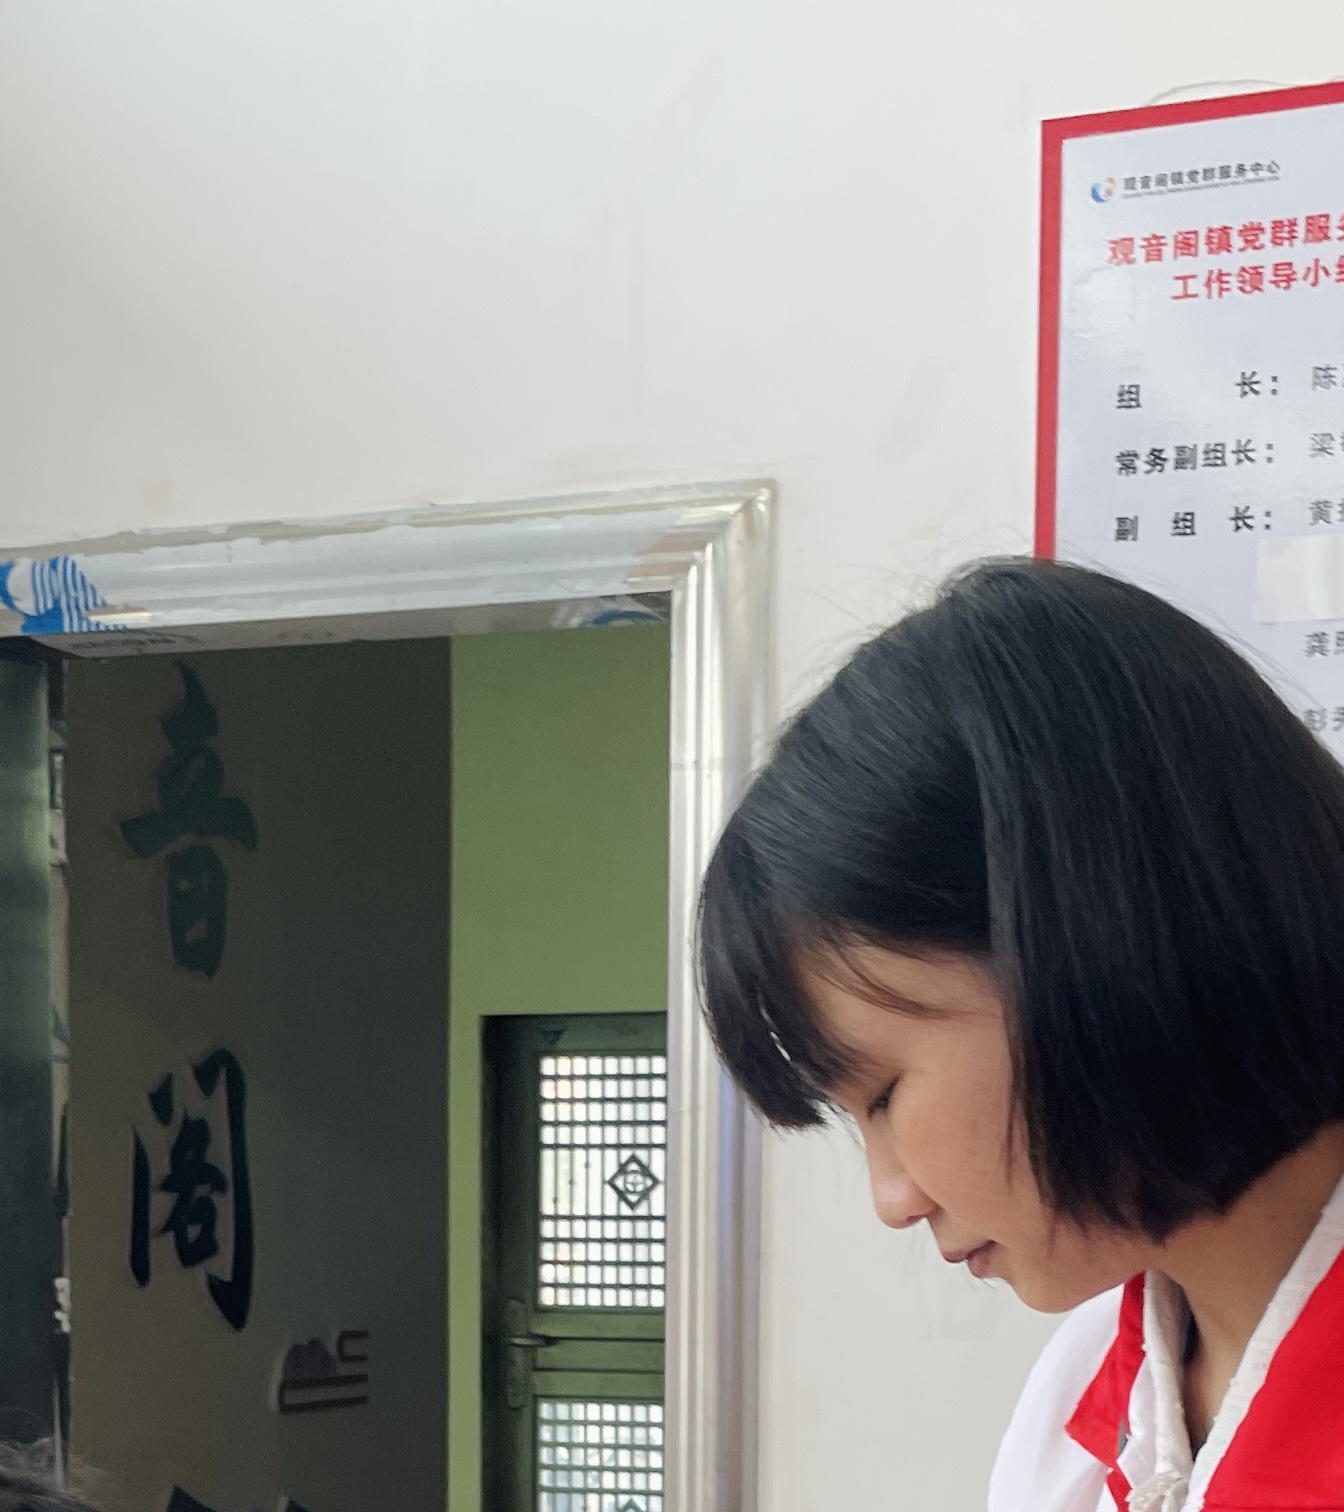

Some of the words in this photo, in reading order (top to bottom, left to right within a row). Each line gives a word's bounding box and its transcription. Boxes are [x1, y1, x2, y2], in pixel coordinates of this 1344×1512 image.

[1116, 384, 1142, 409] 组
[1114, 514, 1139, 542] 副
[1171, 510, 1197, 537] 组
